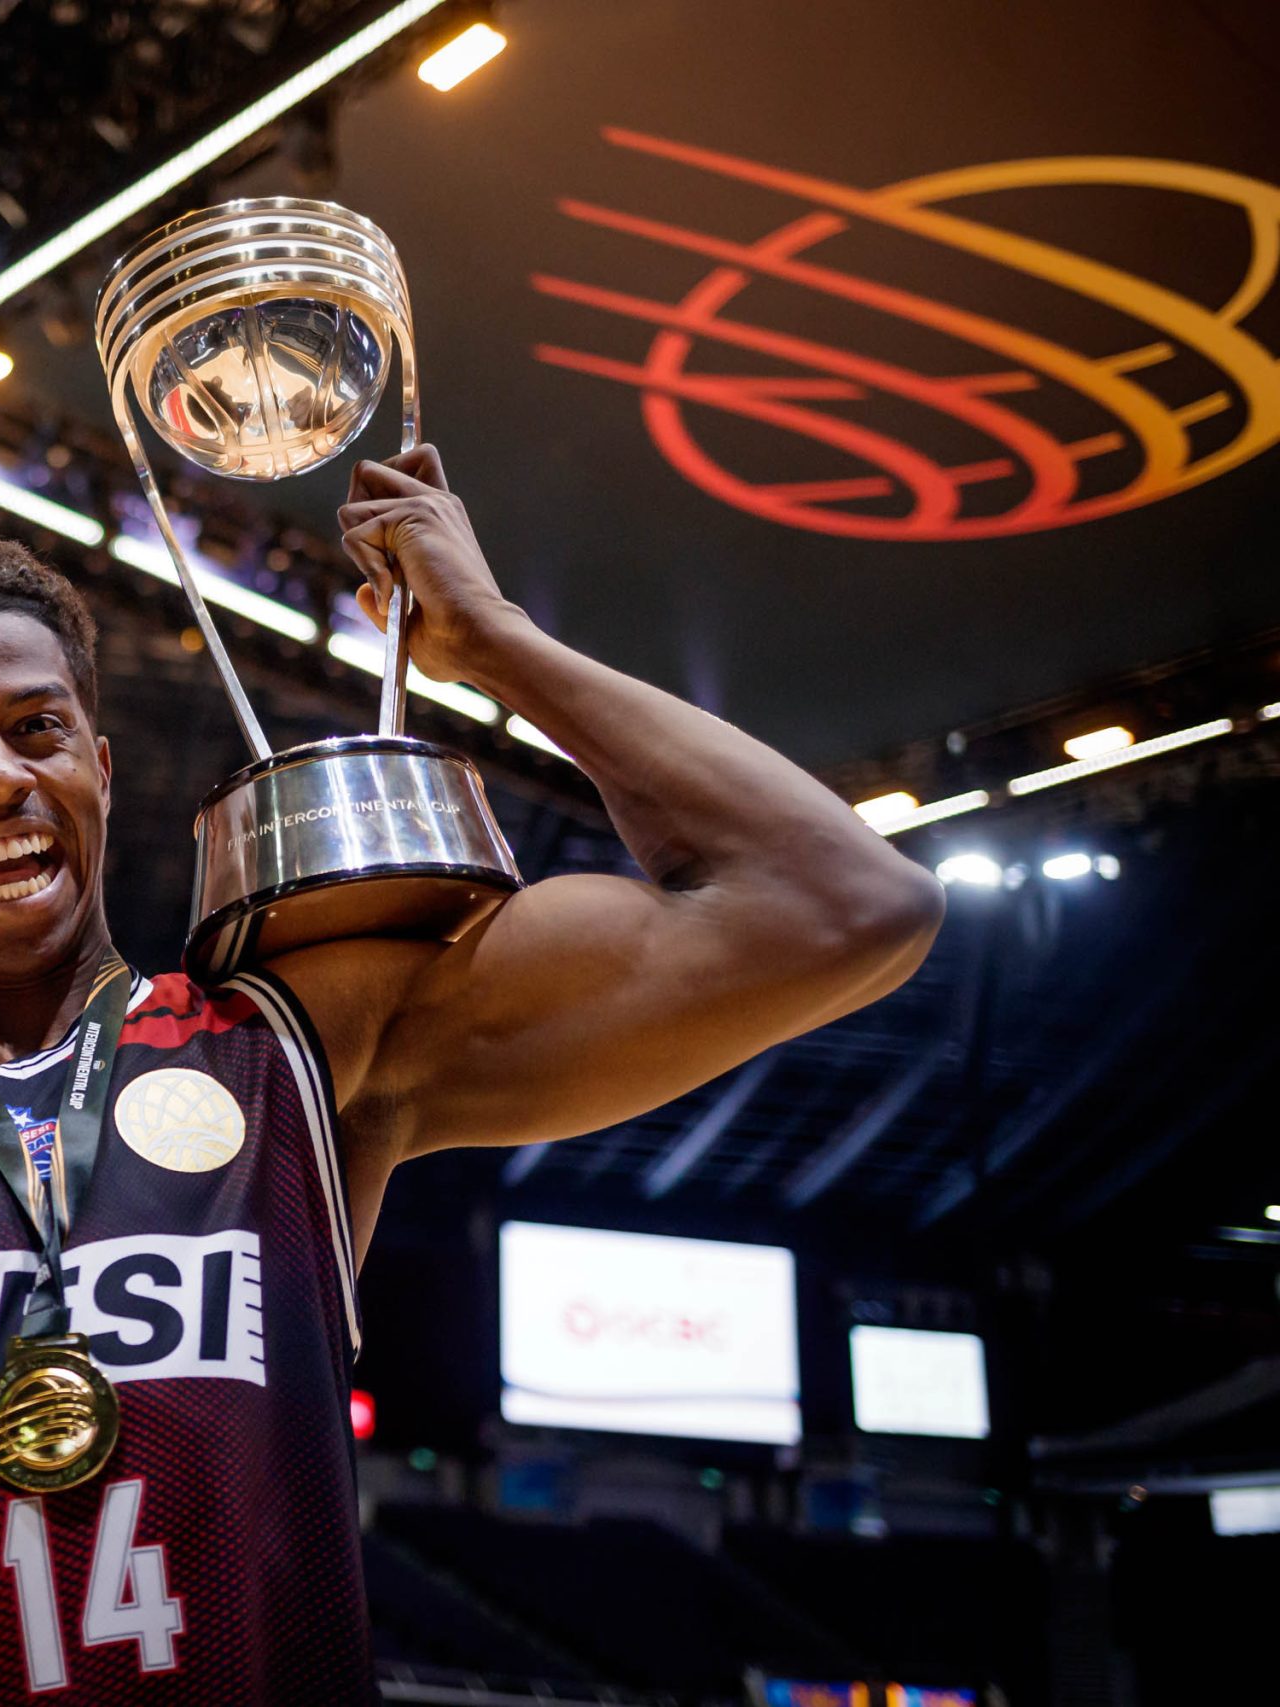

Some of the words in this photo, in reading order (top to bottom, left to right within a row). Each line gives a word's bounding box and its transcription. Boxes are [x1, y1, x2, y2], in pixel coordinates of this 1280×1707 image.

[430, 801, 460, 815] CUP
[73, 1021, 102, 1091] INTERCONTINENTAL
[69, 1092, 86, 1109] CUP
[4, 1478, 184, 1693] 14
